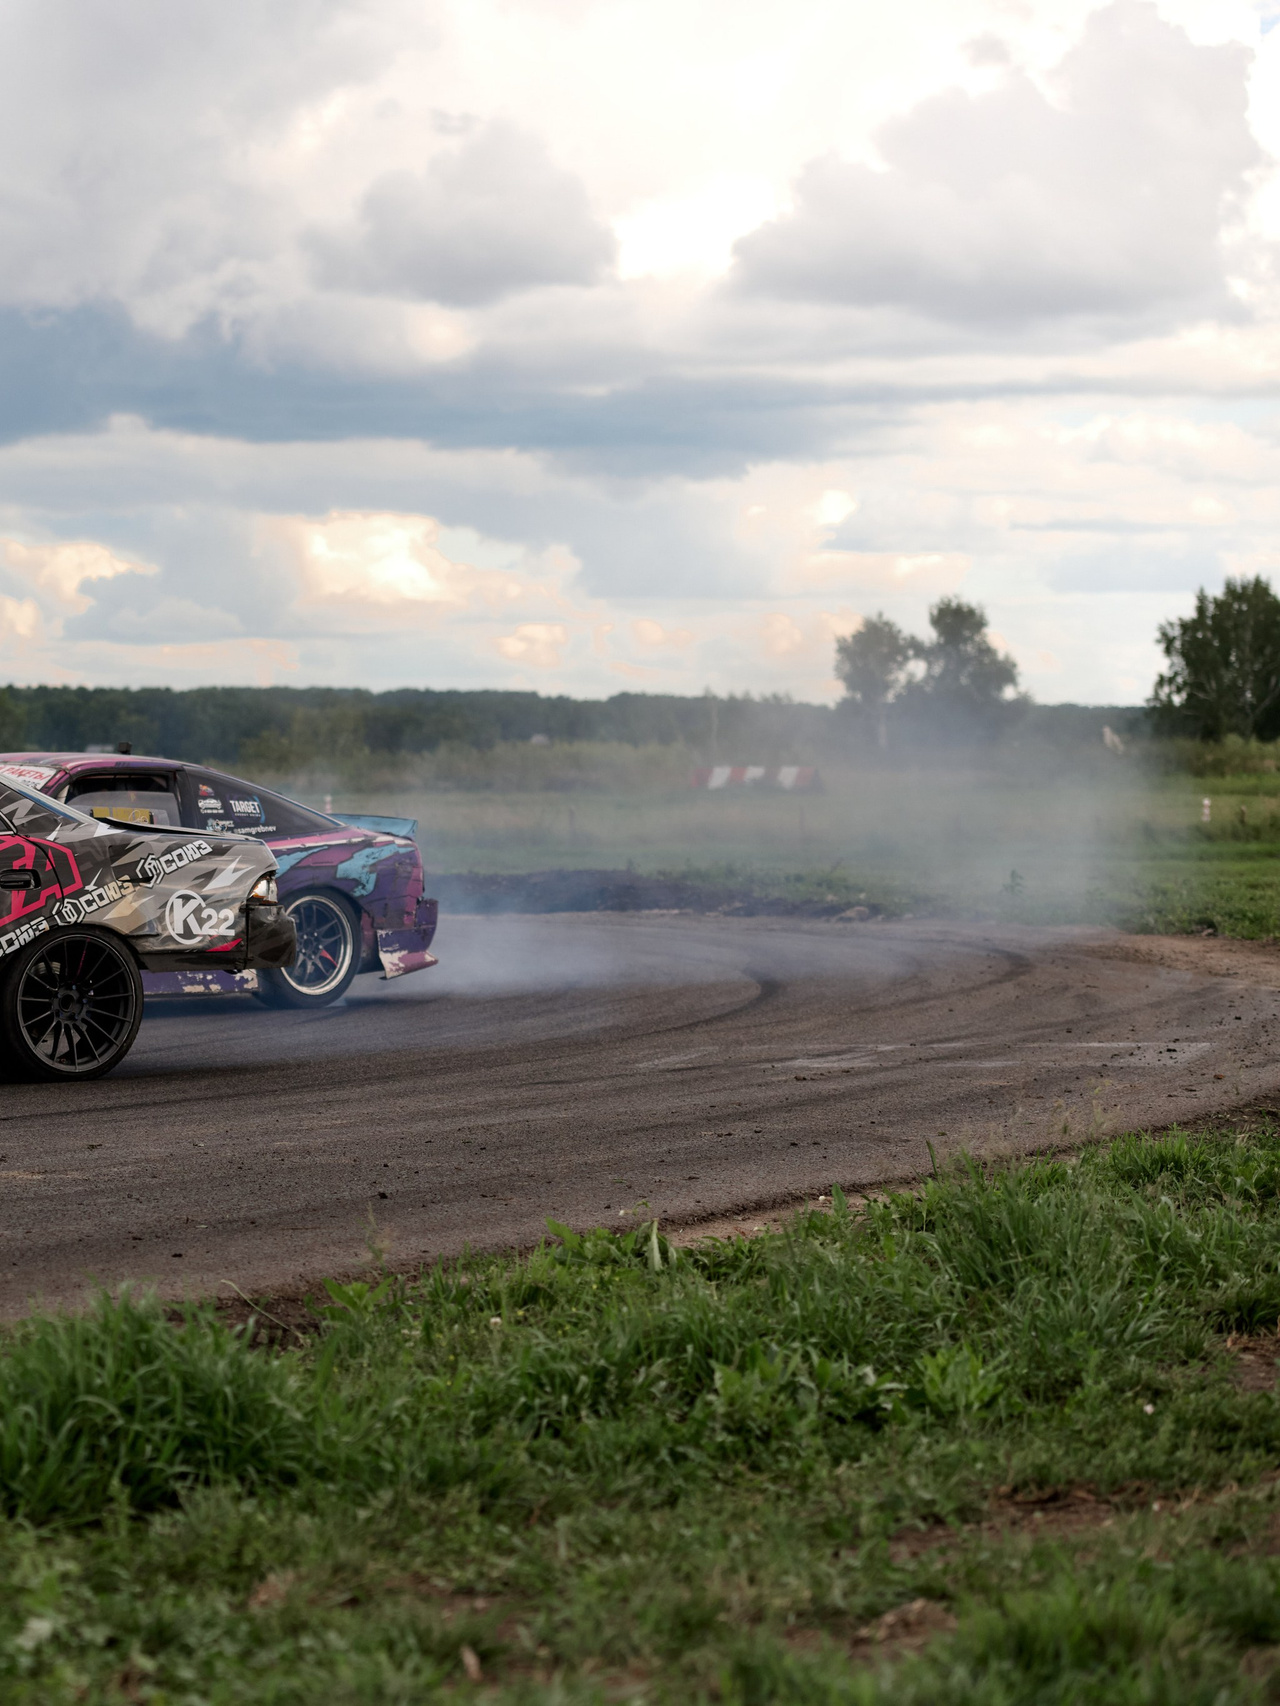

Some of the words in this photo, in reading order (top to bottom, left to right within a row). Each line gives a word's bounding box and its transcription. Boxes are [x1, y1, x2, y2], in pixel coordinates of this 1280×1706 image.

[230, 800, 260, 813] TARGET
[159, 839, 213, 874] СОЮЗ
[78, 873, 136, 914] СОЮЗ
